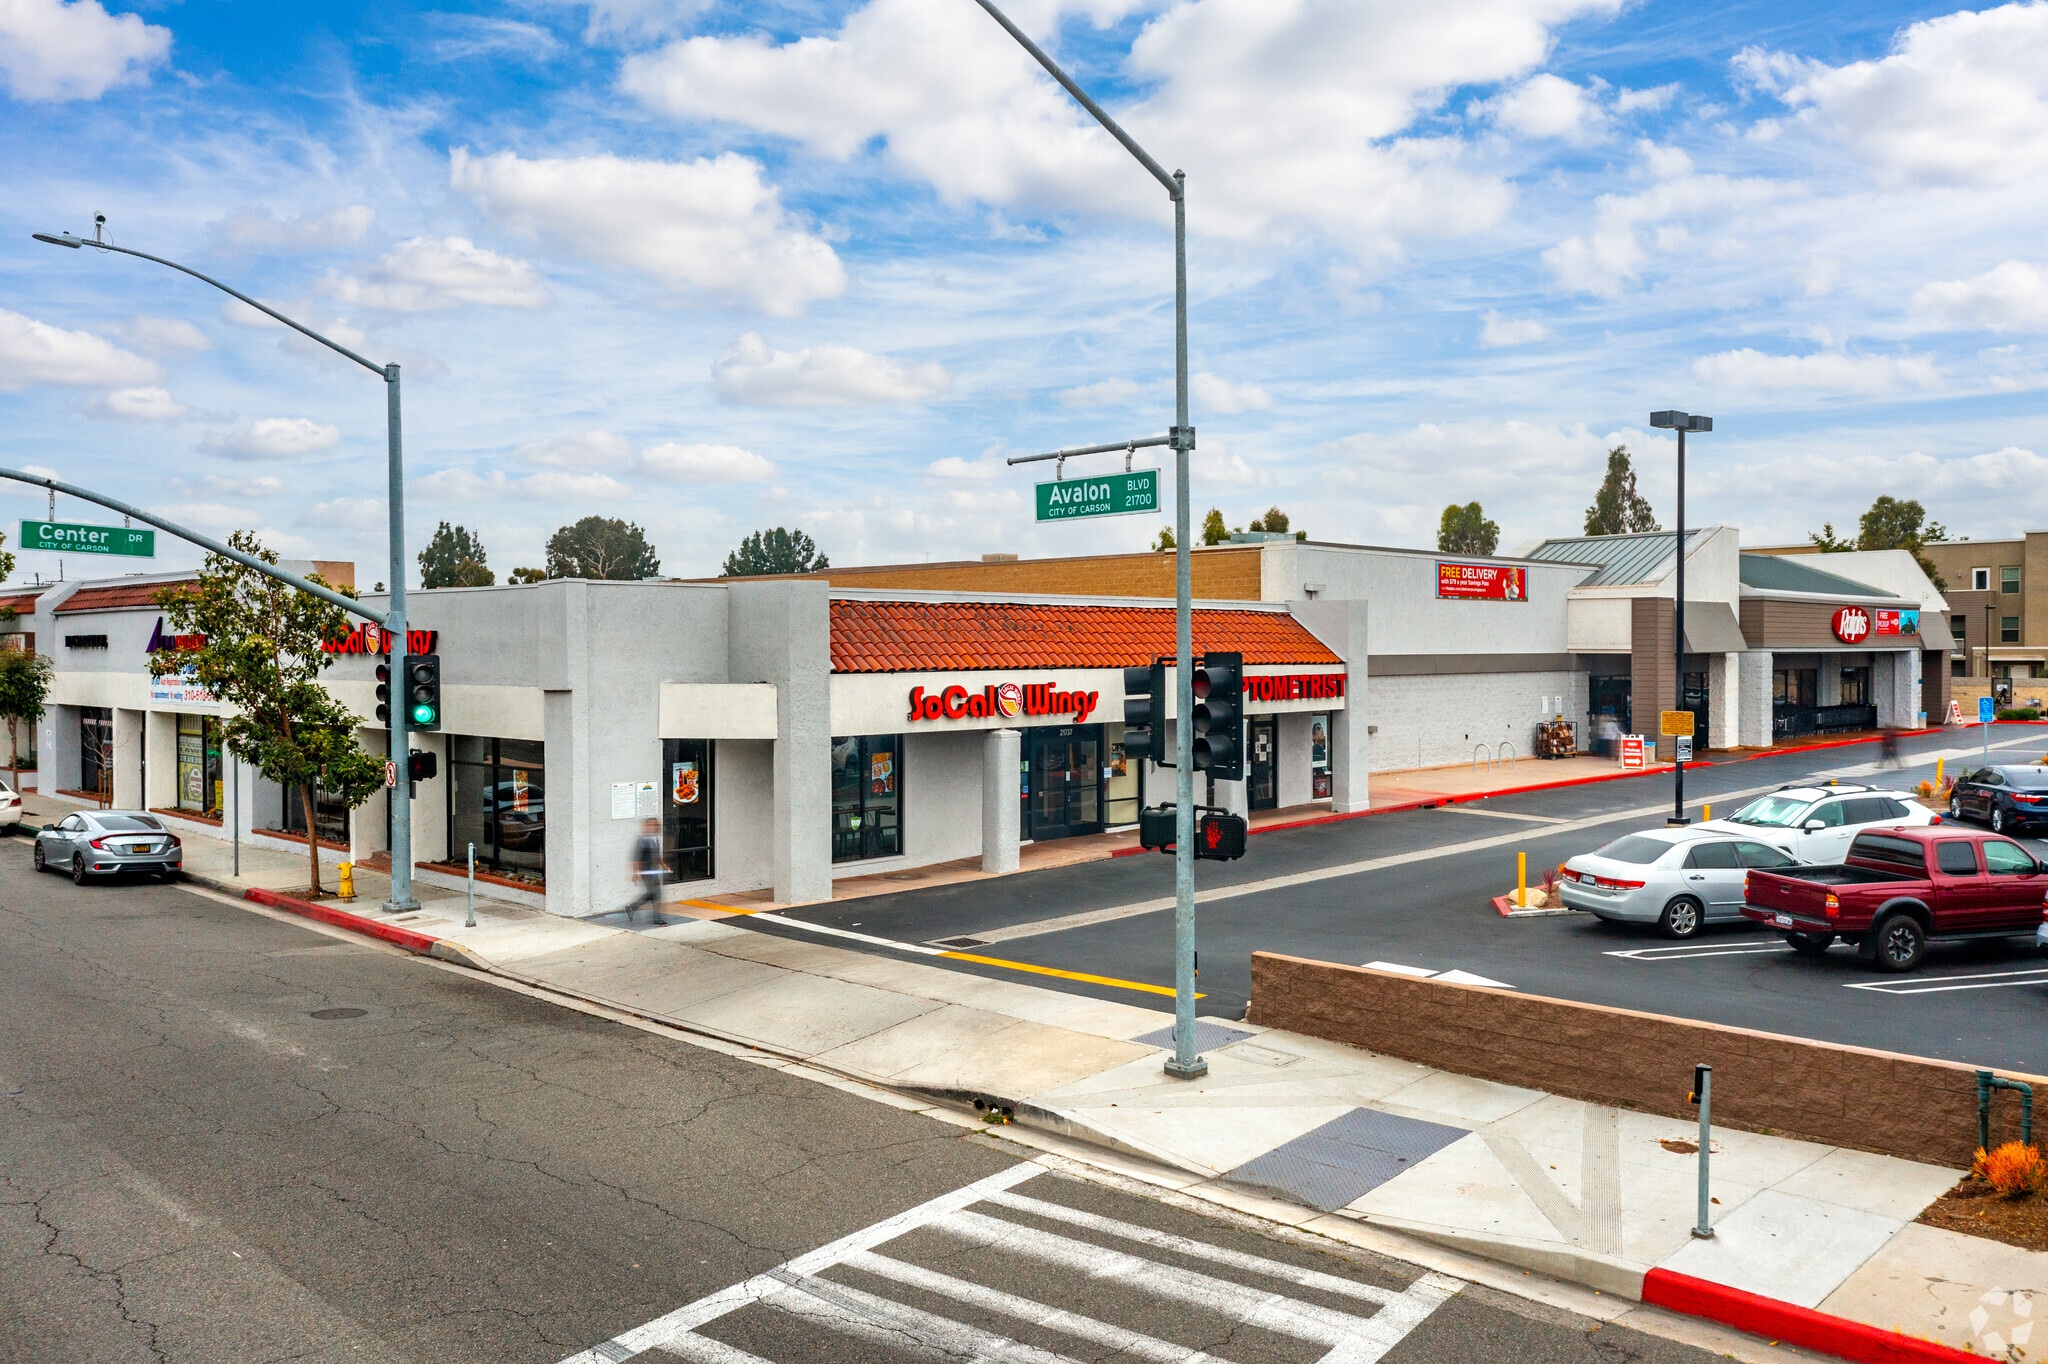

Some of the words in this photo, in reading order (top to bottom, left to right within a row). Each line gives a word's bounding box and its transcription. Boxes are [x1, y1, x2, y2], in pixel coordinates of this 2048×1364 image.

[1049, 482, 1111, 506] Avalon
[1127, 479, 1150, 491] BLVD
[1125, 493, 1152, 507] 21700
[1048, 507, 1065, 517] CITY
[1068, 506, 1078, 515] OF
[1080, 503, 1111, 514] CARSON
[39, 524, 110, 544] Center
[128, 534, 143, 543] DR
[39, 541, 59, 549] CITY
[61, 542, 72, 550] OF
[75, 544, 110, 553] CARSON
[1440, 566, 1461, 579] FREE
[1462, 567, 1498, 581] DELIVERY
[1839, 608, 1868, 641] Ralphs
[1879, 611, 1889, 620] FREE
[320, 622, 364, 655] oCal
[1242, 673, 1348, 702] PTOMETRIST
[909, 684, 995, 721] SoCal
[1023, 682, 1099, 723] Wings
